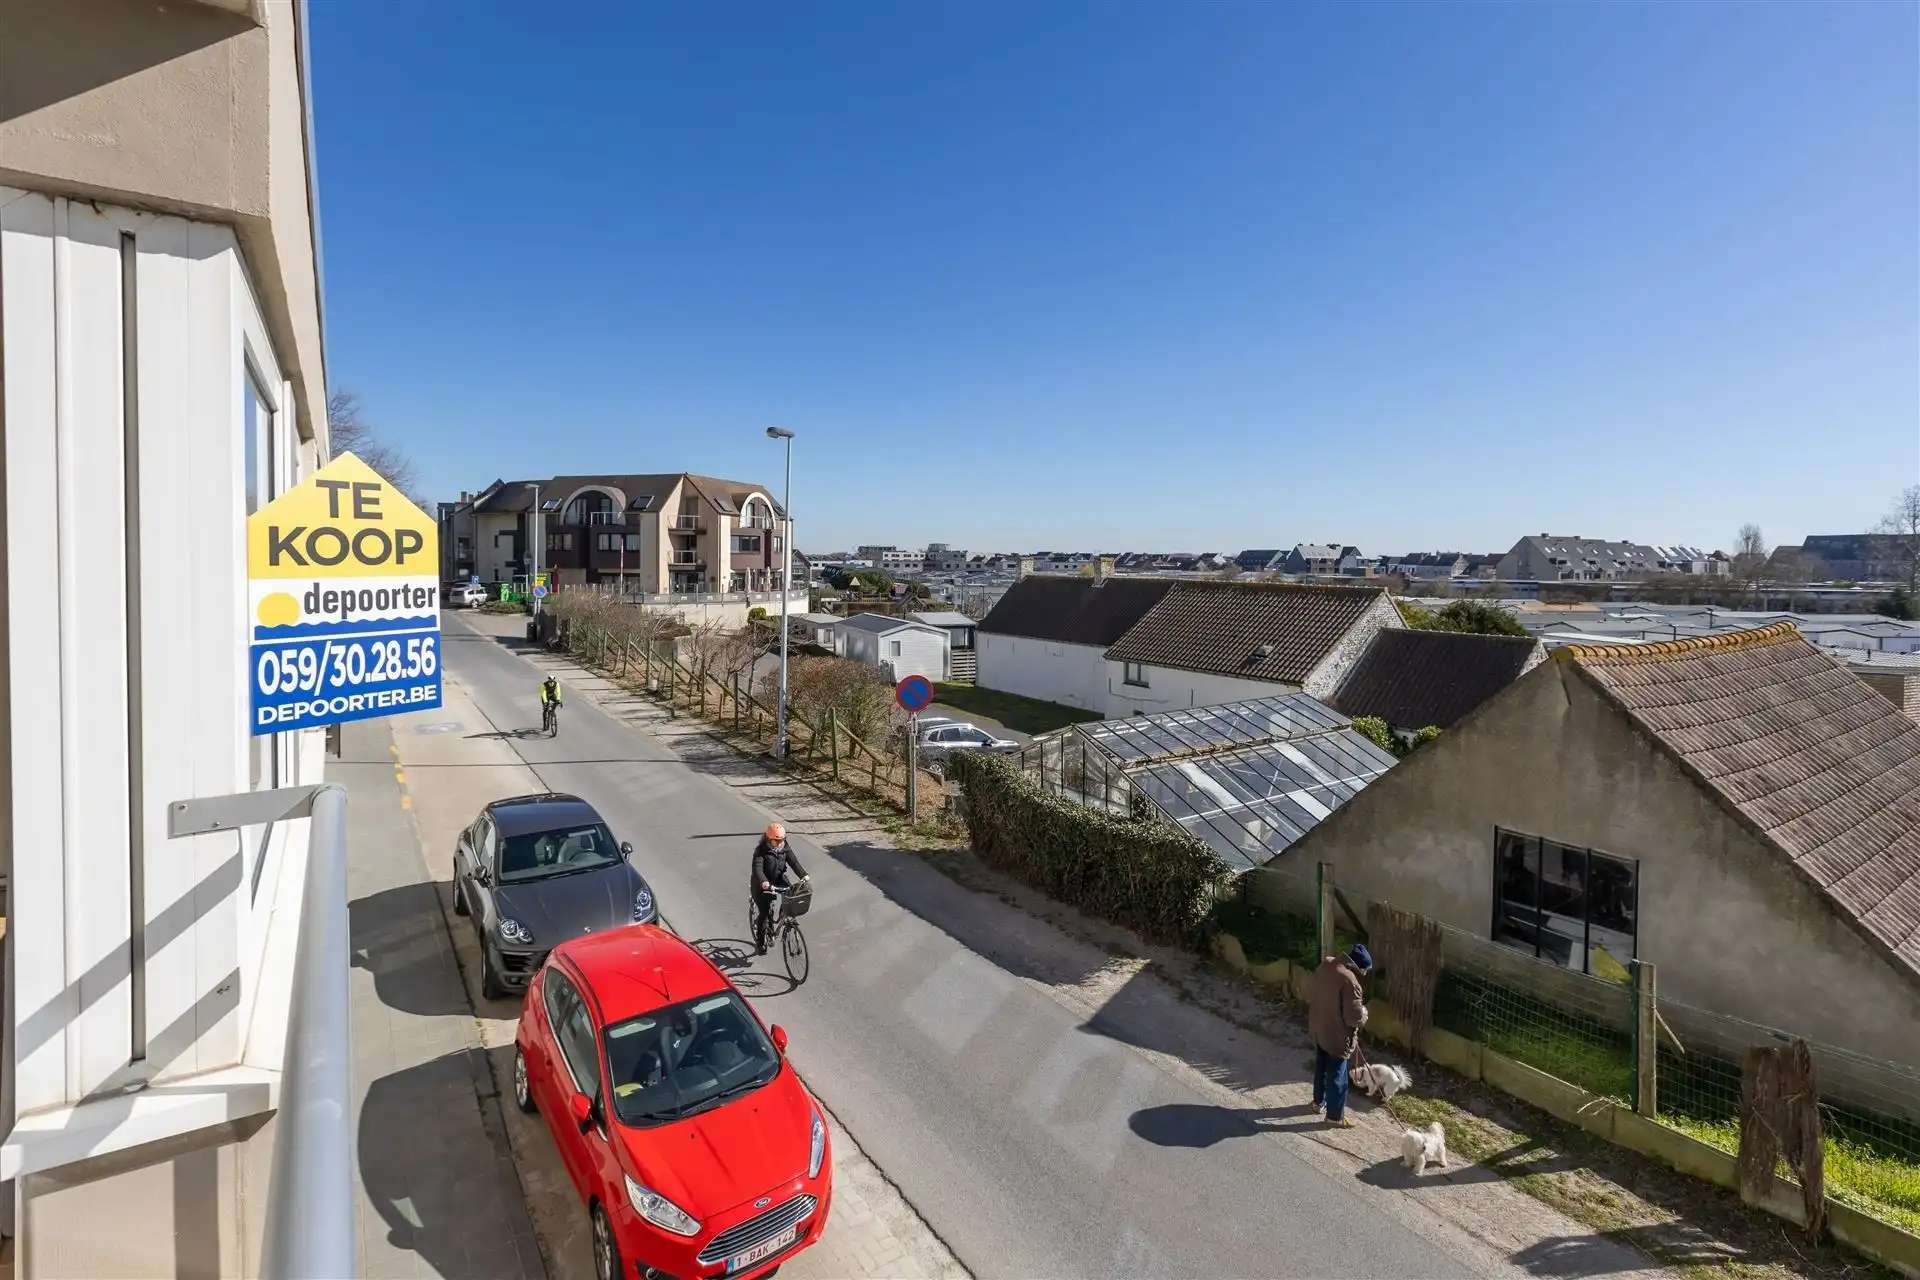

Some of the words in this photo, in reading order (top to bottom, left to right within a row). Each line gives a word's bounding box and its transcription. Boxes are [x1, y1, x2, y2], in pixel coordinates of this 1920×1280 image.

[316, 479, 383, 520] TE
[269, 526, 424, 567] KOOP
[303, 582, 437, 620] depoorter
[257, 637, 437, 697] 059/30.28.56
[257, 684, 437, 726] DEPOORTER.BE
